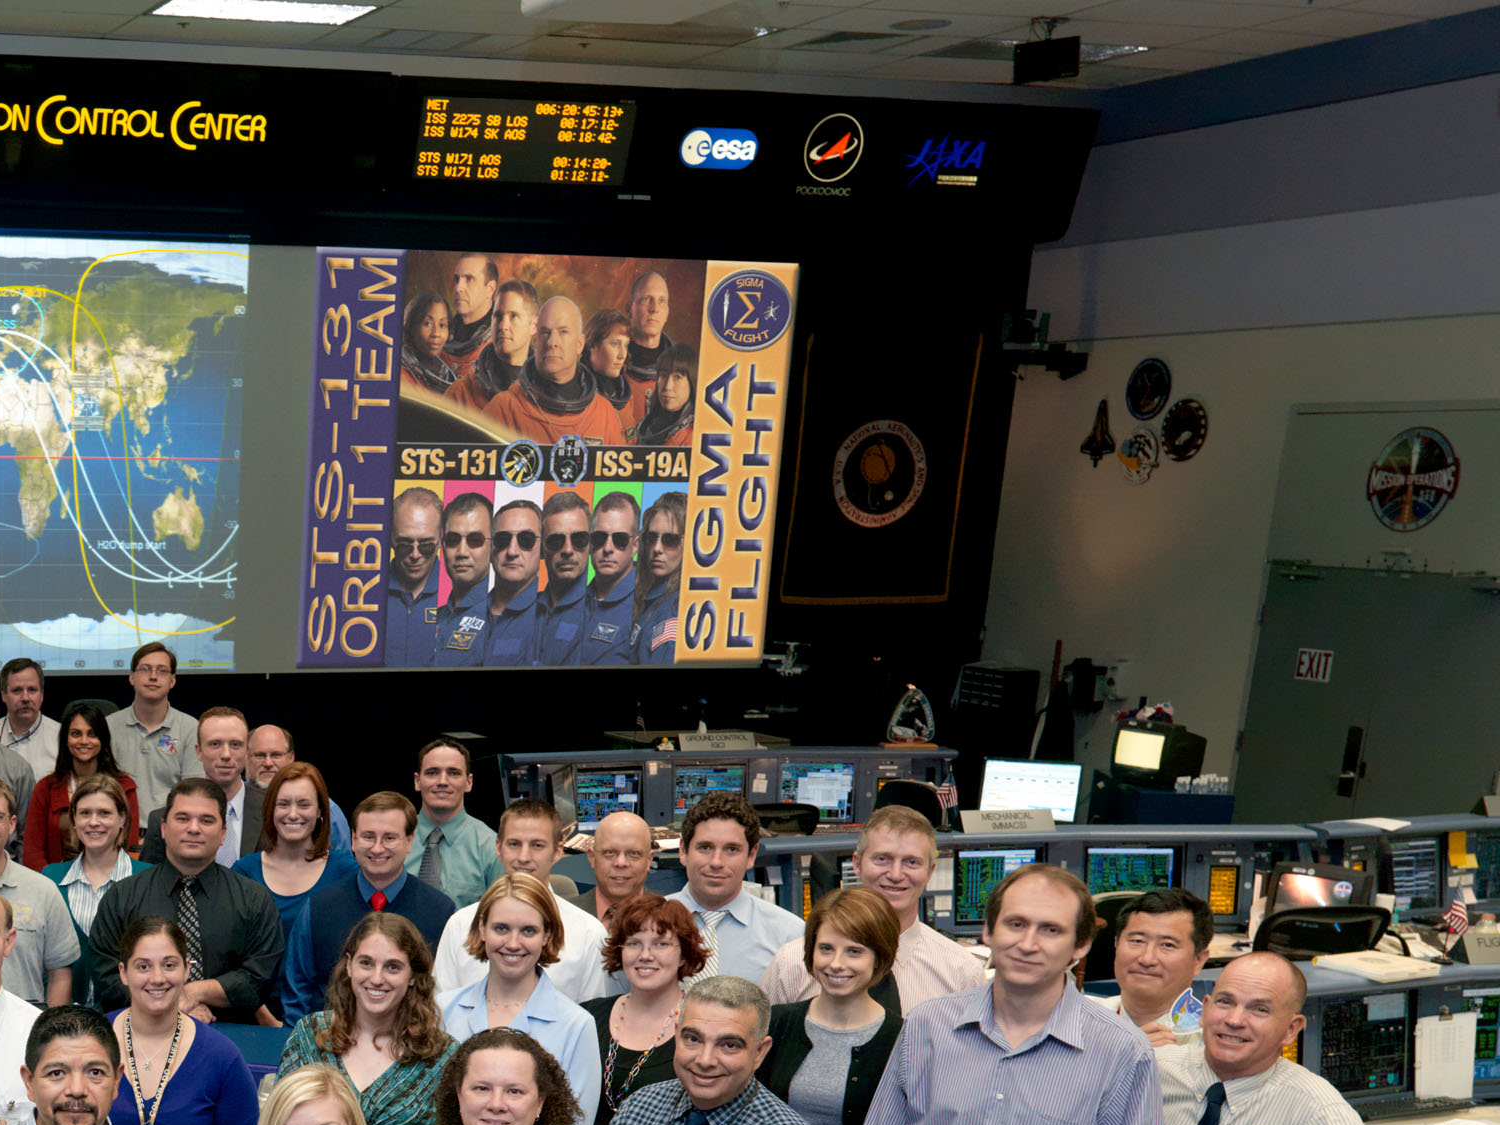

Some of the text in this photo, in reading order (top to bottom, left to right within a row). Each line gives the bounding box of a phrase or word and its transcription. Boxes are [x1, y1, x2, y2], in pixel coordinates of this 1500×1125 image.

[426, 100, 449, 111] MET
[425, 113, 447, 125] ISS
[486, 115, 501, 126] SB
[506, 116, 528, 127] LOS
[423, 126, 445, 137] ISS
[484, 128, 498, 140] SK
[504, 129, 526, 141] AOS
[418, 152, 441, 164] STS
[479, 154, 501, 166] AOS
[712, 139, 756, 161] esa
[416, 166, 438, 177] STS
[477, 167, 499, 179] LOS
[736, 278, 763, 289] SIGMA
[724, 329, 769, 342] FLIGHT
[308, 255, 355, 655] STS-131
[340, 257, 398, 657] ORBIT 1 TEAM
[401, 449, 497, 476] STS-131
[595, 451, 687, 477] ISS-19A
[685, 363, 738, 652] SIGMA
[727, 365, 777, 649] FLIGHT
[1296, 651, 1332, 680] EXIT
[982, 812, 1034, 820] MECHANICAL
